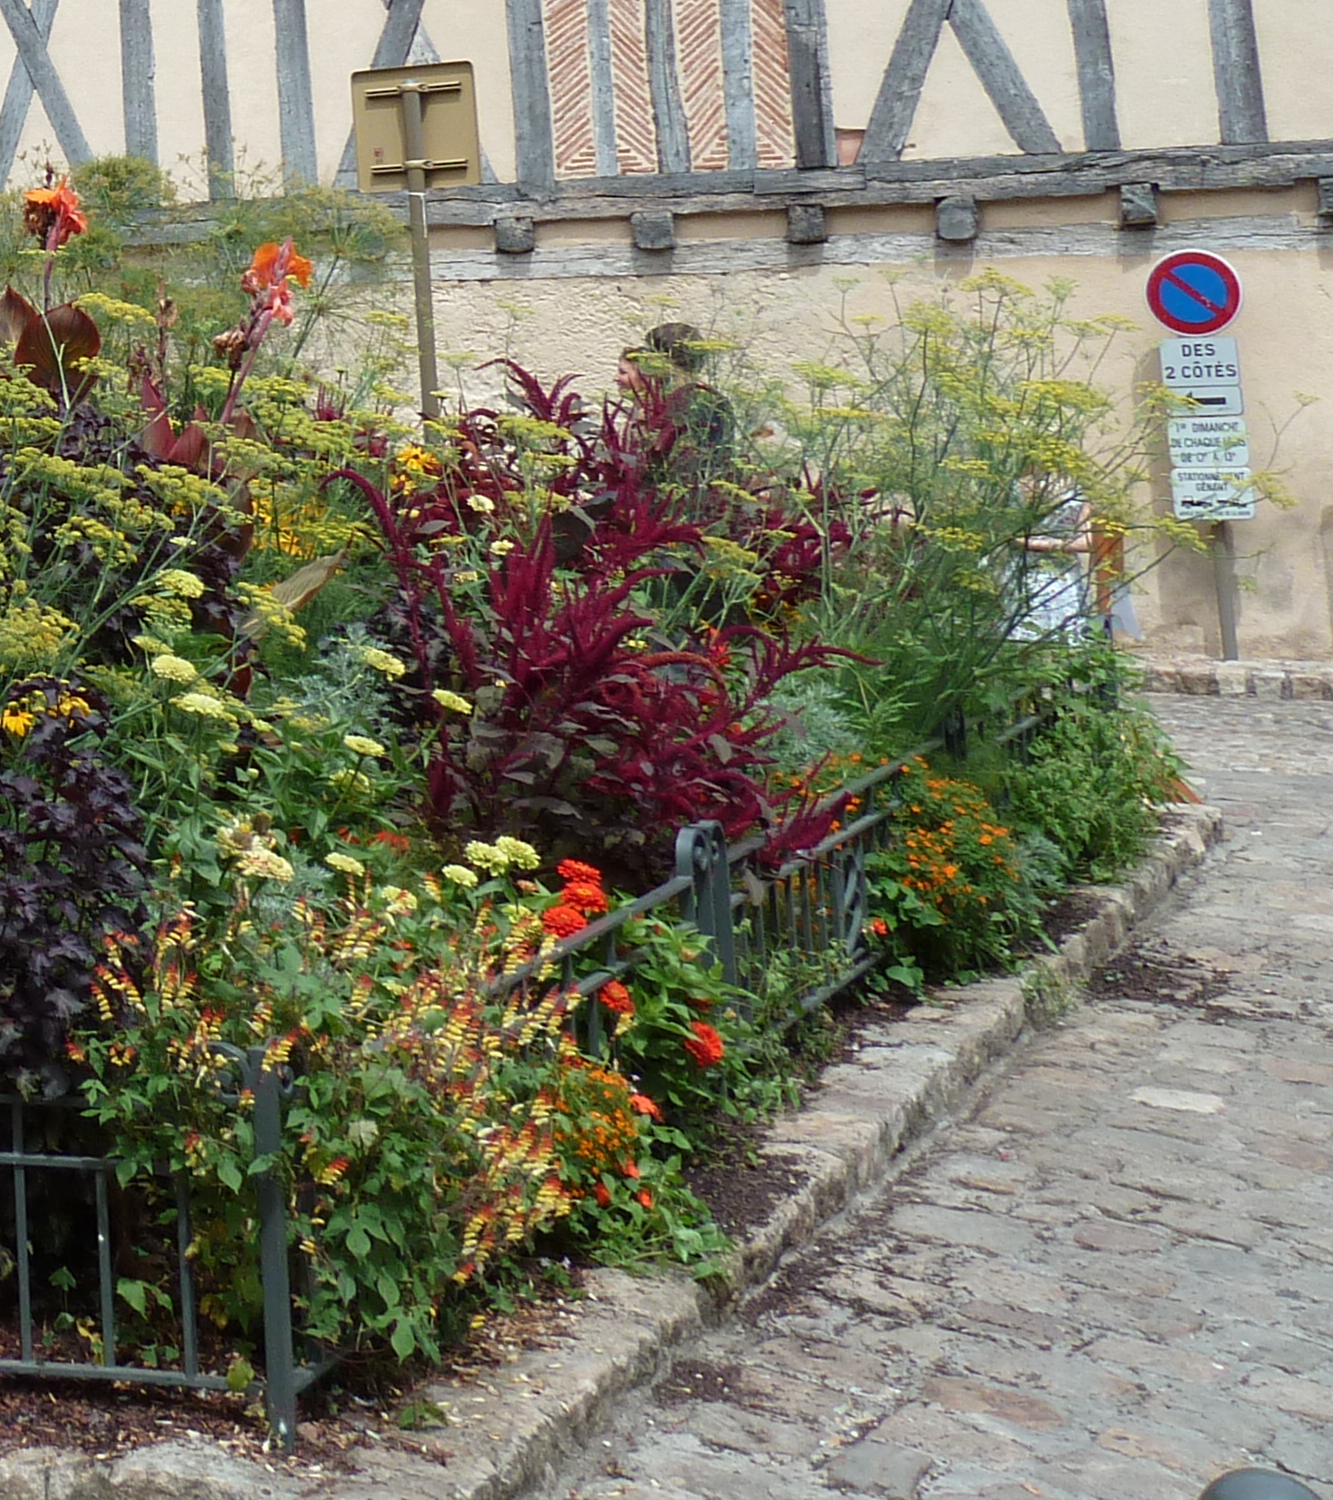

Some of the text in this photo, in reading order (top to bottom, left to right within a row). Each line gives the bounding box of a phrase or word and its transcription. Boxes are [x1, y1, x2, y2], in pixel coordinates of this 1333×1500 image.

[1181, 344, 1216, 357] DES
[1165, 361, 1237, 379] 2 CÔTÉS
[1192, 422, 1239, 433] DIMANCHE
[1184, 437, 1221, 448] CHAQUE
[1222, 437, 1246, 449] MIS
[1177, 472, 1245, 482] STATIONNENT
